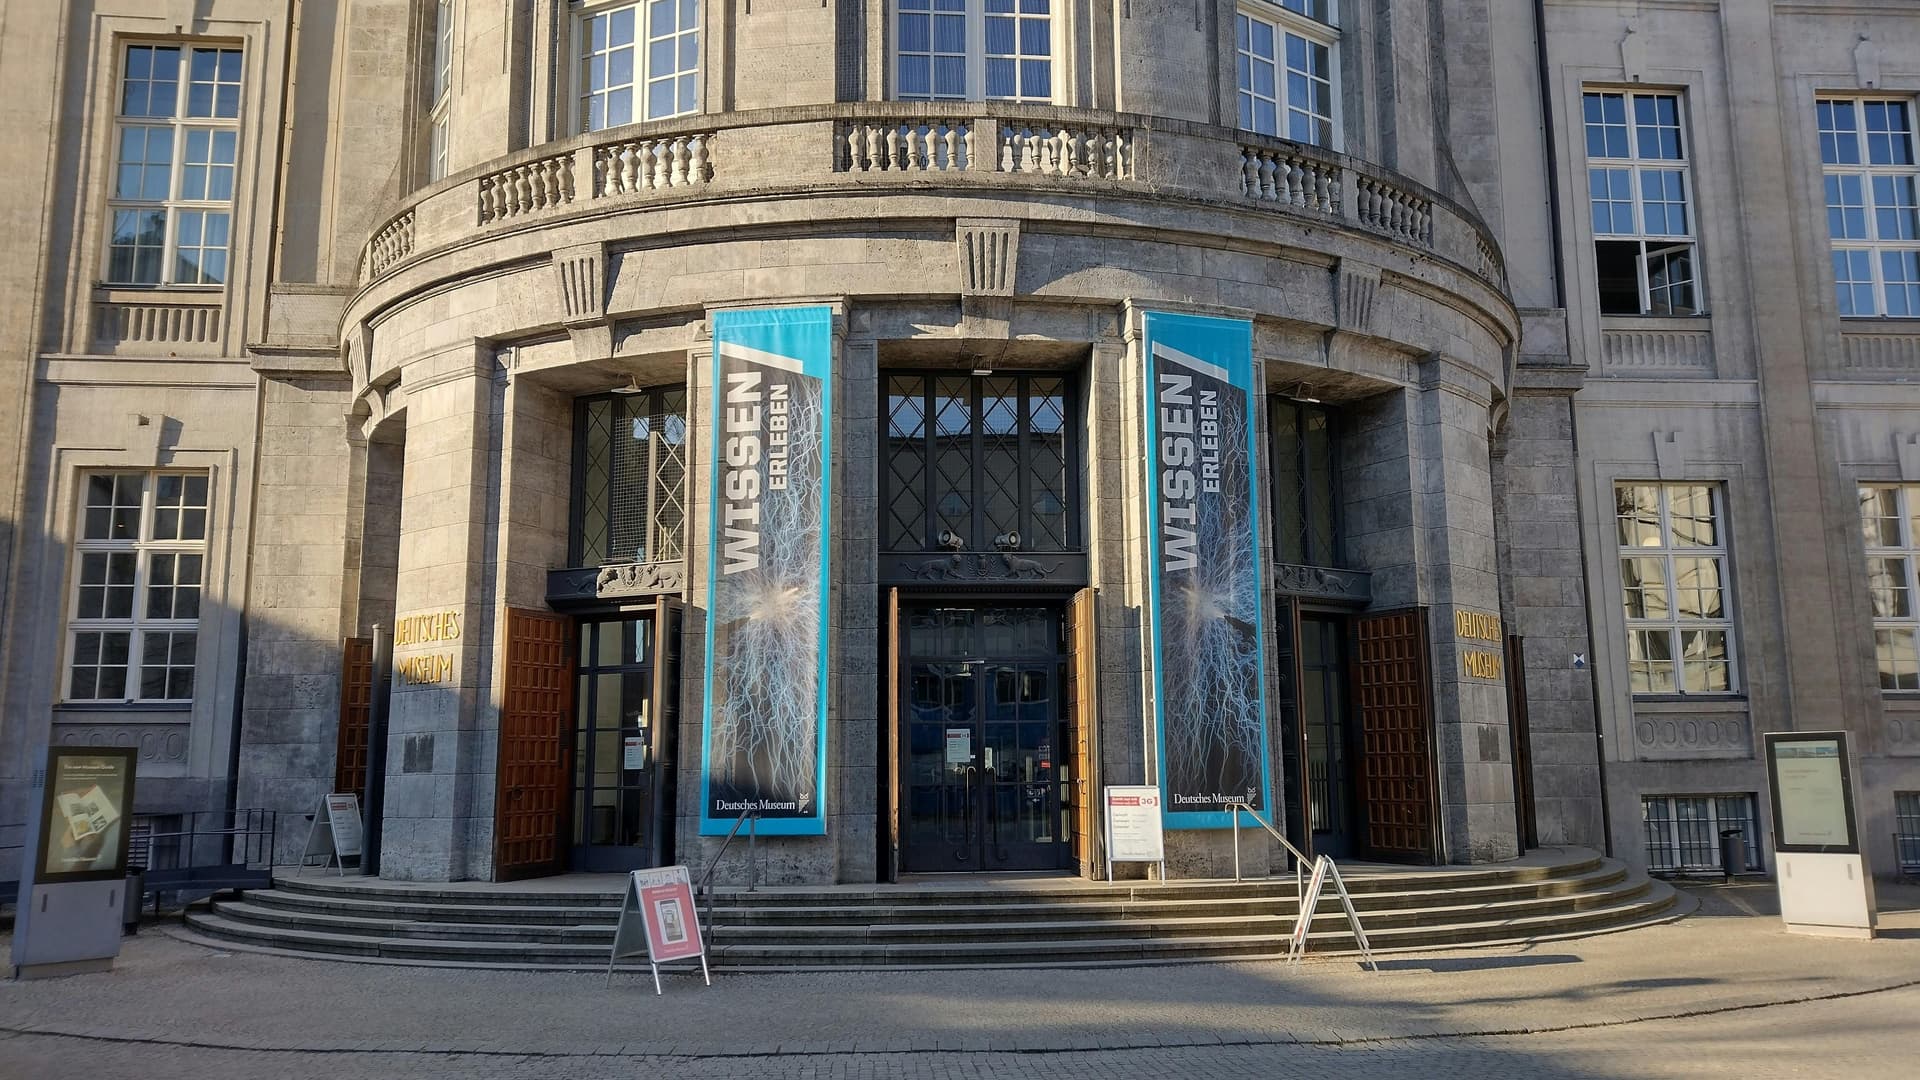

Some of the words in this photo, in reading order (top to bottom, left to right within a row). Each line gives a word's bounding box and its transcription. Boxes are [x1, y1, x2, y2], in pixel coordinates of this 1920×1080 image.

[769, 384, 788, 490] ERLEBEN
[1200, 390, 1220, 493] ERLEBEN
[724, 371, 762, 575] WISSEN
[1160, 373, 1198, 572] WISSEN
[396, 610, 461, 646] DEUTSCHES
[397, 653, 453, 687] MUSEUM
[1463, 649, 1501, 680] MUSEUM
[716, 798, 757, 811] Deutsches
[759, 799, 796, 811] Museum
[1141, 797, 1153, 805] 3G
[1174, 792, 1211, 804] Deutsches
[1212, 792, 1245, 804] Museum
